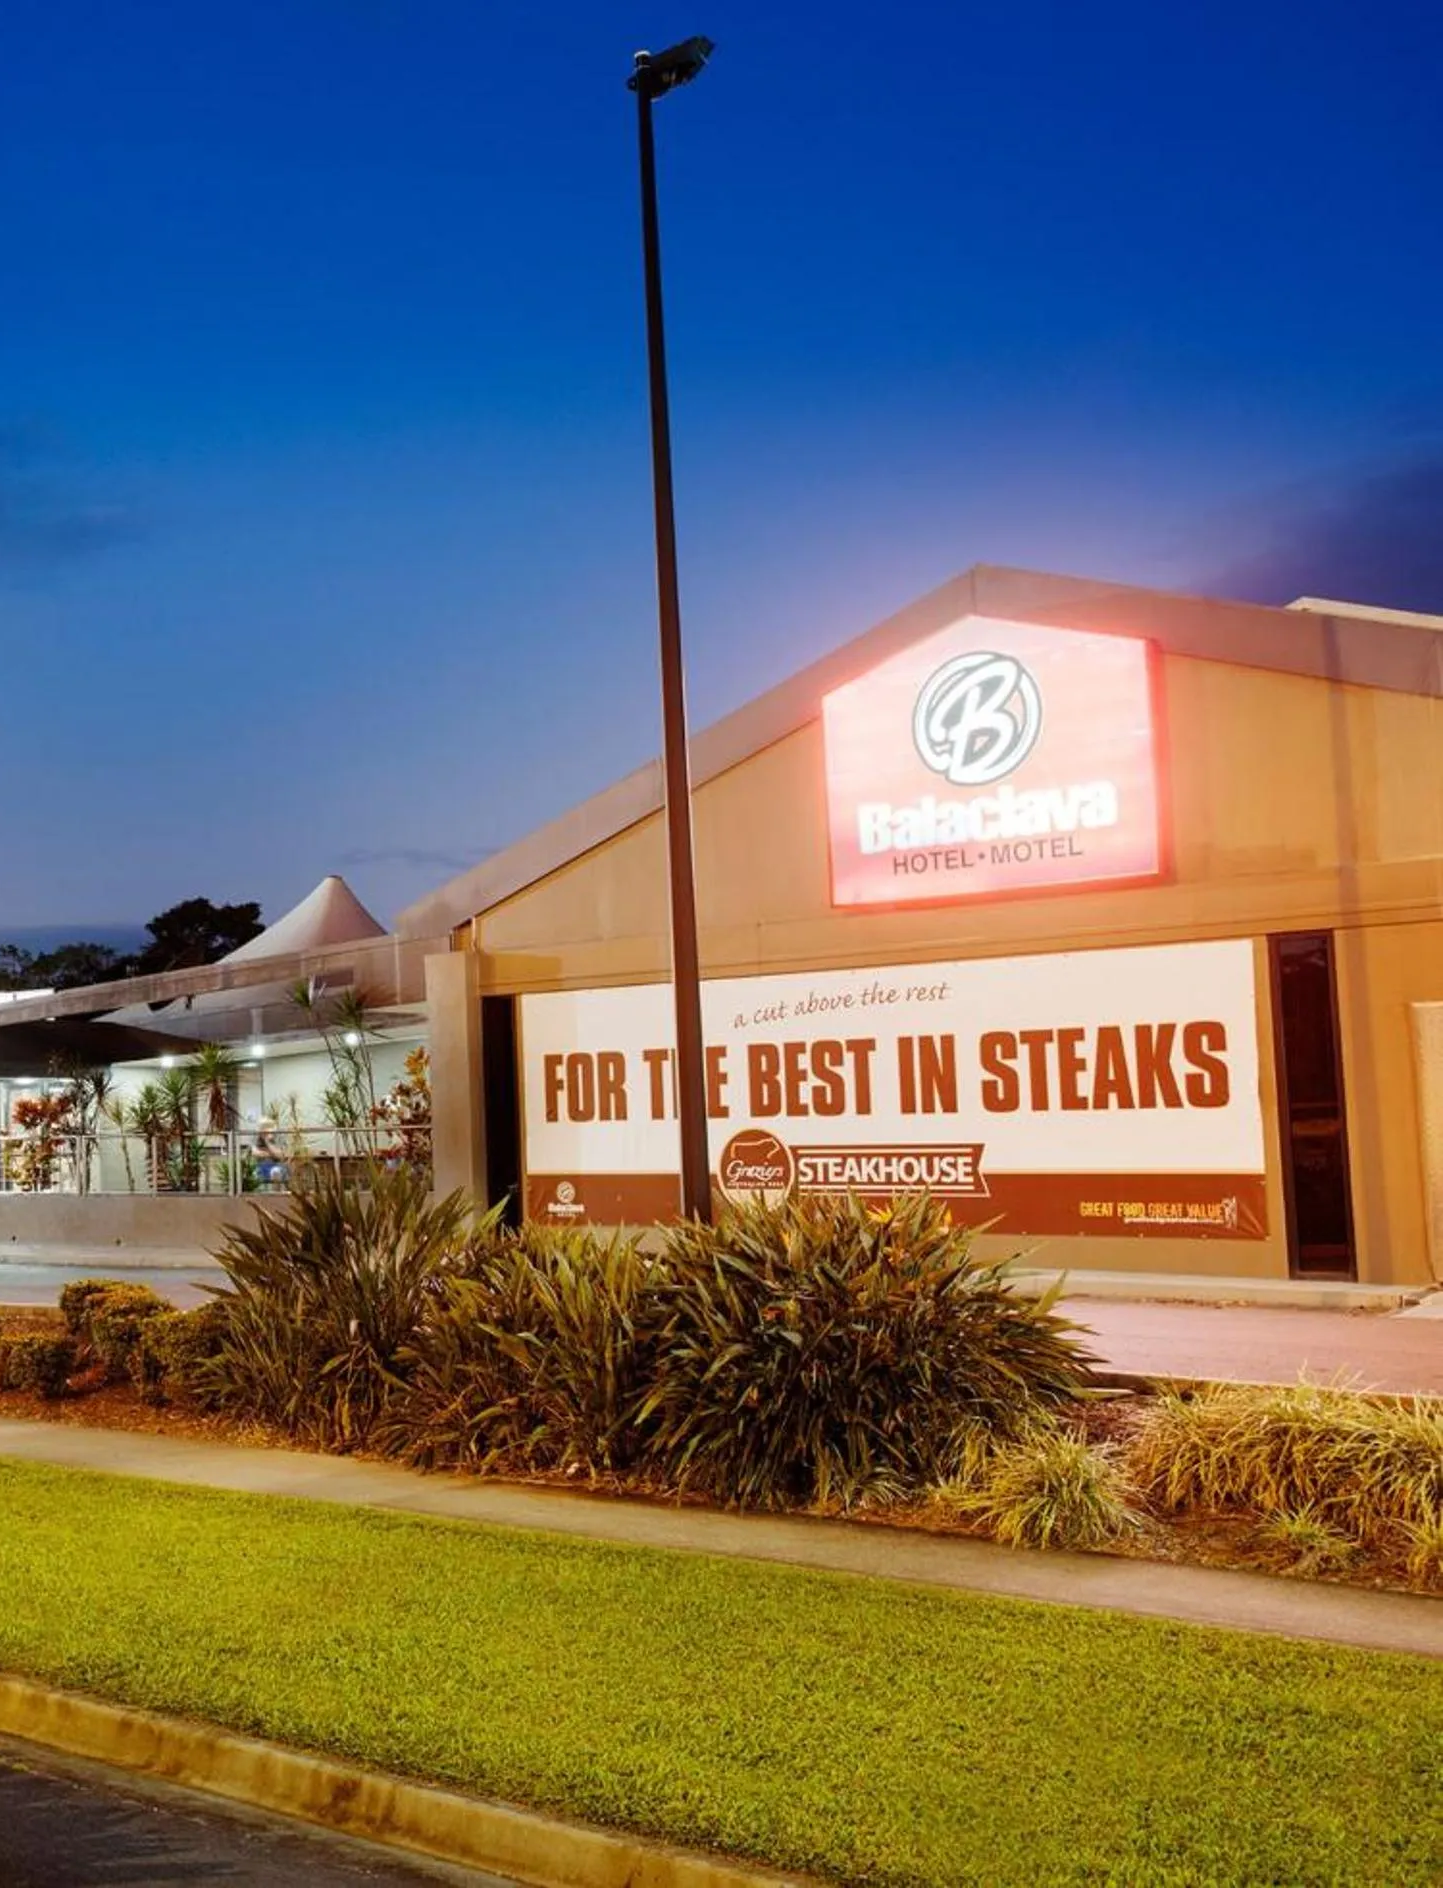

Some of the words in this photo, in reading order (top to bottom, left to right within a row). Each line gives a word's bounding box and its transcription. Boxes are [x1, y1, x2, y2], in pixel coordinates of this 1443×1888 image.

[859, 784, 1116, 853] Balaclava
[733, 1012, 747, 1029] a
[752, 1001, 788, 1024] cut
[794, 990, 855, 1017] above
[860, 981, 899, 1005] the
[905, 982, 950, 1001] rest
[544, 1052, 628, 1123] FOR
[643, 1045, 729, 1121] TE
[747, 1038, 876, 1117] BEST
[897, 1033, 959, 1115] IN
[979, 1020, 1230, 1112] STEAKS
[797, 1155, 975, 1184] STEAKHOUSE
[1080, 1201, 1114, 1216] GREAT
[1117, 1201, 1146, 1217] FOOD
[1148, 1202, 1183, 1217] GREAT
